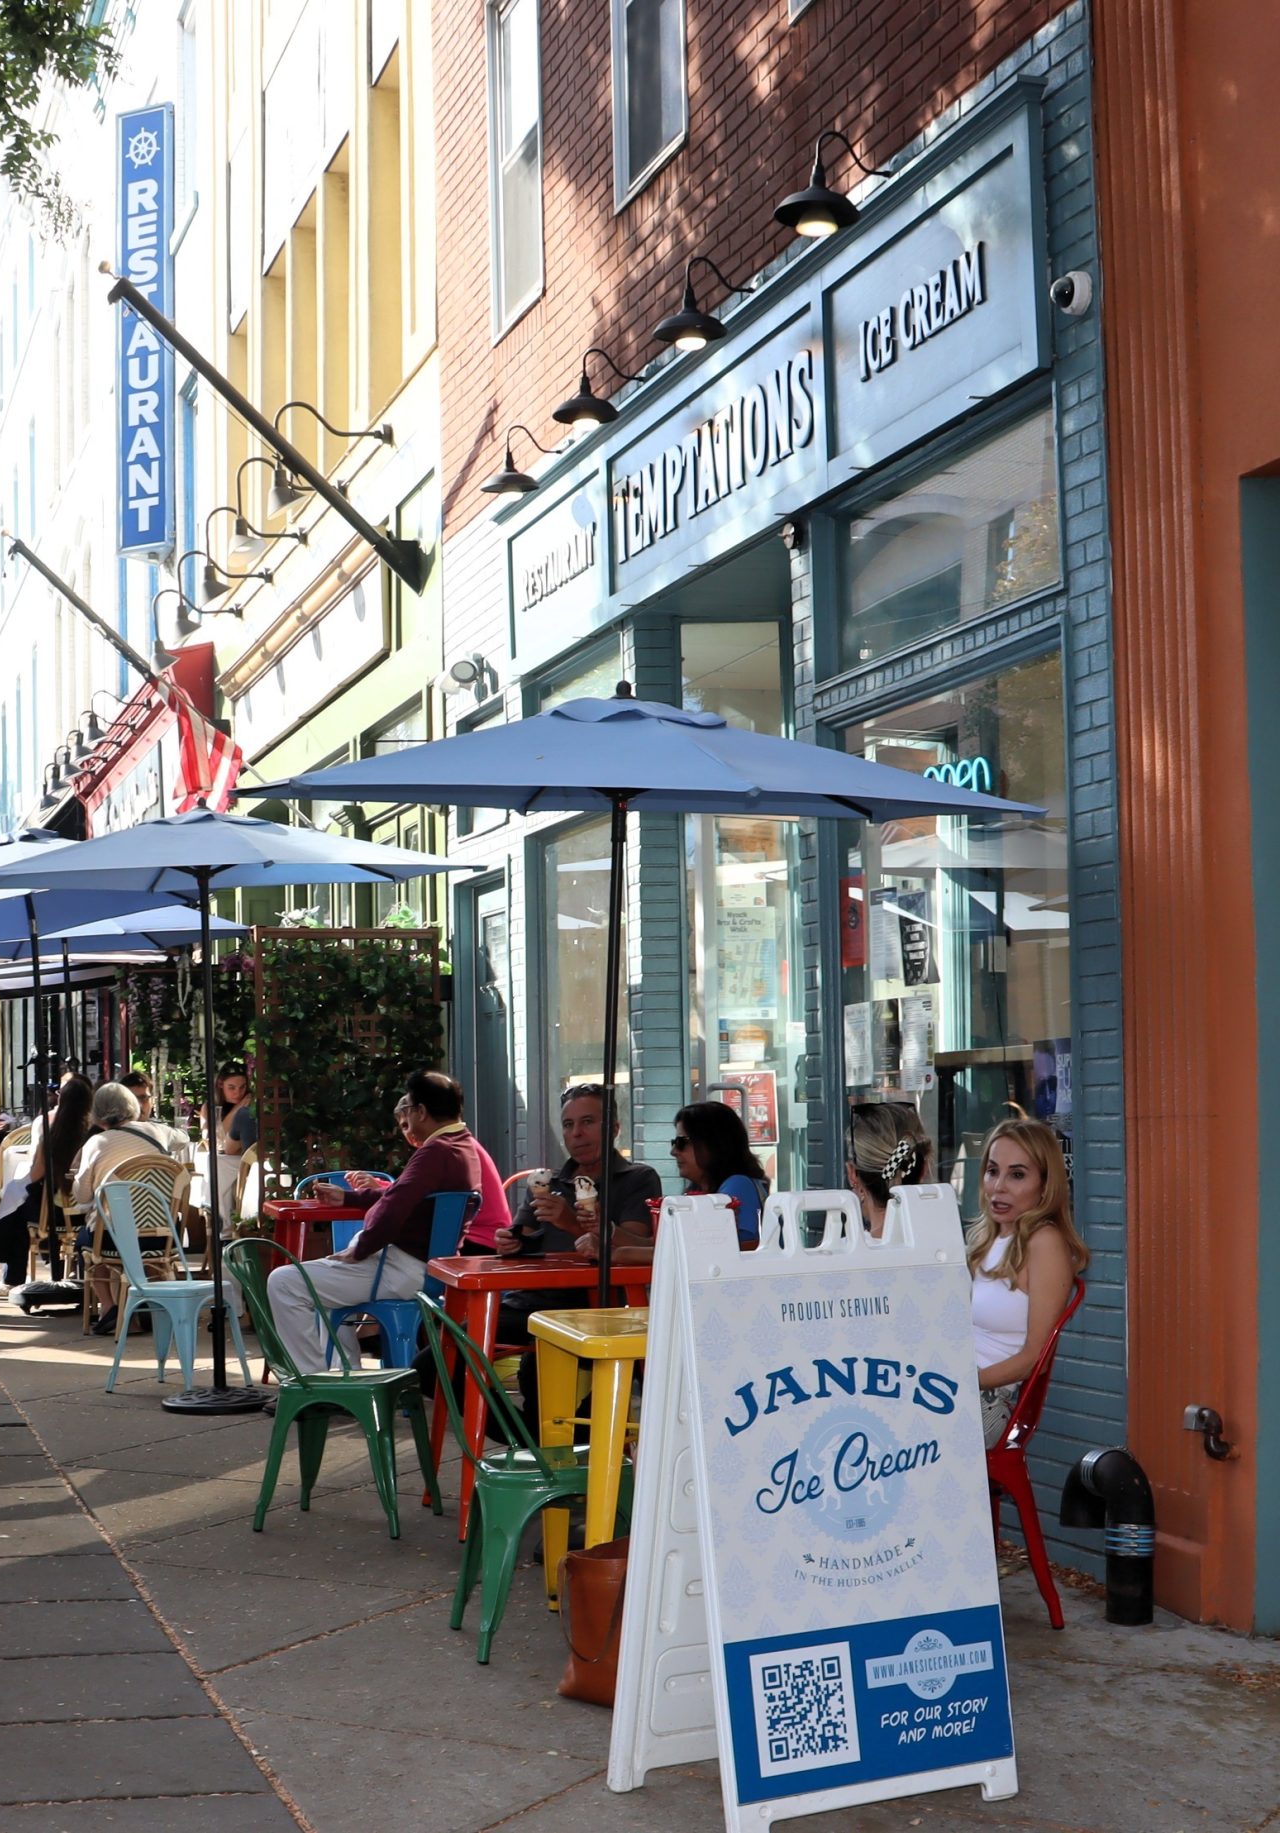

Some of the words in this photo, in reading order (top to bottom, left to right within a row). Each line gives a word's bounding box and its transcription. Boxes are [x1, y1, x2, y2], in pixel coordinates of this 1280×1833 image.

[858, 306, 897, 382] ICE
[899, 241, 986, 350] CREAM
[613, 349, 815, 565] TEMPTATIONS
[522, 522, 596, 612] RESTAURANT
[1057, 1053, 1072, 1067] SUP
[1058, 1068, 1072, 1088] FU
[1058, 1089, 1072, 1103] PAR
[781, 1300, 833, 1322] PROUDLY
[840, 1296, 890, 1318] SERVING
[725, 1357, 958, 1436] JANE'S
[756, 1448, 824, 1514] Ice
[834, 1432, 941, 1492] Cream
[794, 1569, 807, 1580] IN
[811, 1575, 832, 1587] THE
[837, 1574, 884, 1587] HUDSON
[887, 1551, 924, 1577] VALLEY
[819, 1545, 902, 1570] HANDMADE
[873, 1650, 987, 1680] WWW.JANESICECREAM.COM
[881, 1711, 908, 1728] FOR
[914, 1705, 942, 1722] OUR
[947, 1697, 988, 1718] STORY
[898, 1728, 926, 1745] AND
[932, 1716, 976, 1739] MORE!
